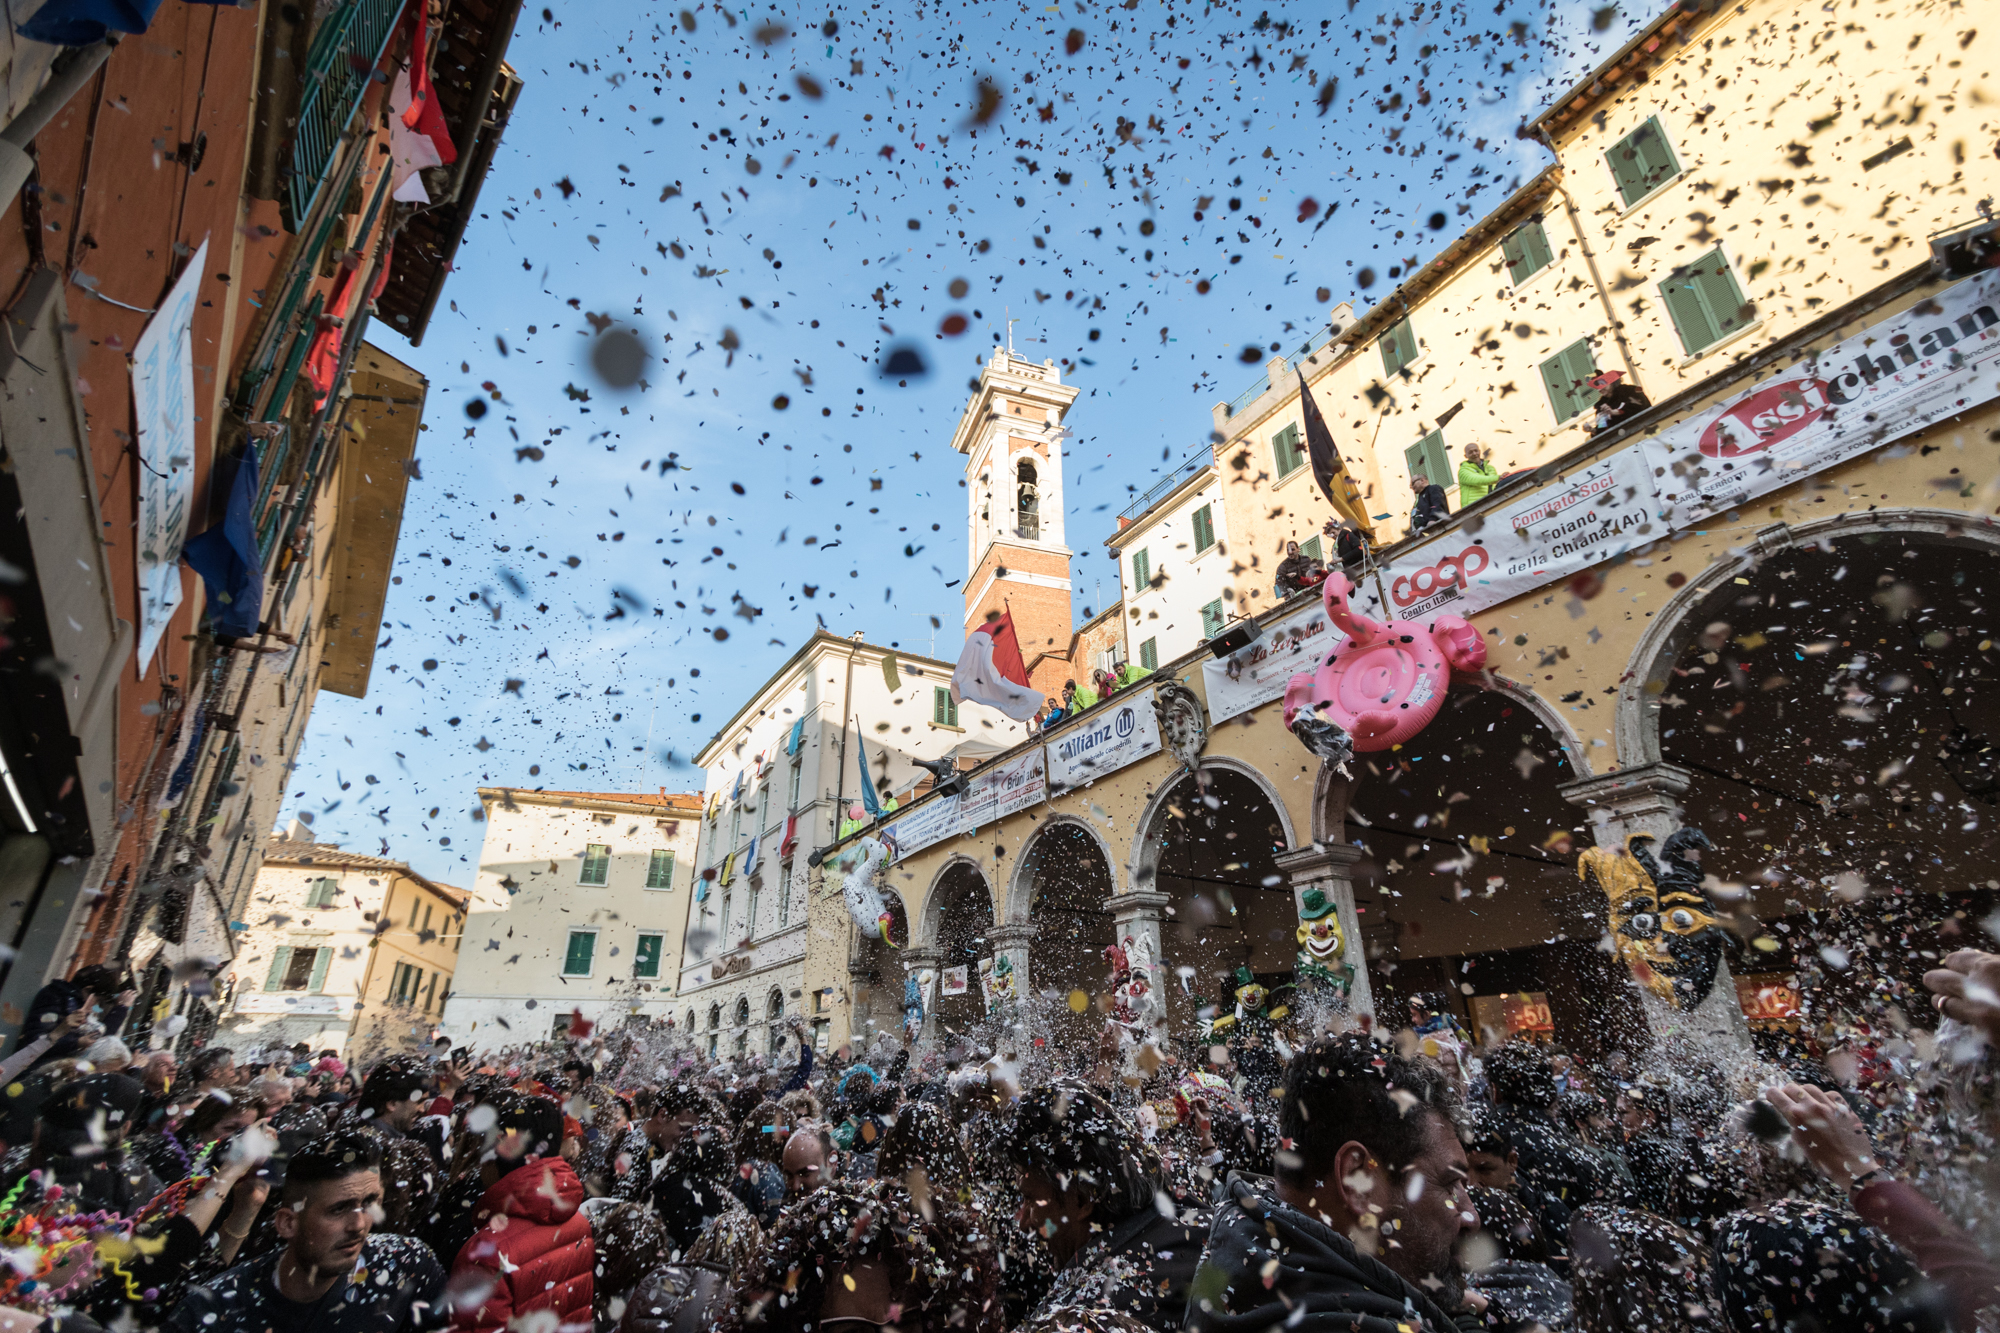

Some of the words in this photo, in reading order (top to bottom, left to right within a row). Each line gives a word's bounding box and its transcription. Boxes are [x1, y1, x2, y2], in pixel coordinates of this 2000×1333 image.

[1872, 387, 1900, 402] Carlo
[1901, 368, 1940, 389] Serotti
[1777, 469, 1791, 480] Via
[1791, 459, 1822, 475] Coona
[1512, 495, 1576, 530] Comitato
[1579, 473, 1615, 500] Soci
[1674, 490, 1702, 505] CARLO
[1704, 470, 1748, 493] SERROTTI
[1508, 554, 1548, 576] della
[1551, 526, 1610, 560] Chiana
[1615, 508, 1649, 536] (Ar)
[1541, 511, 1597, 544] Foiano
[1401, 602, 1431, 620] Centro
[1064, 724, 1112, 759] Allianz
